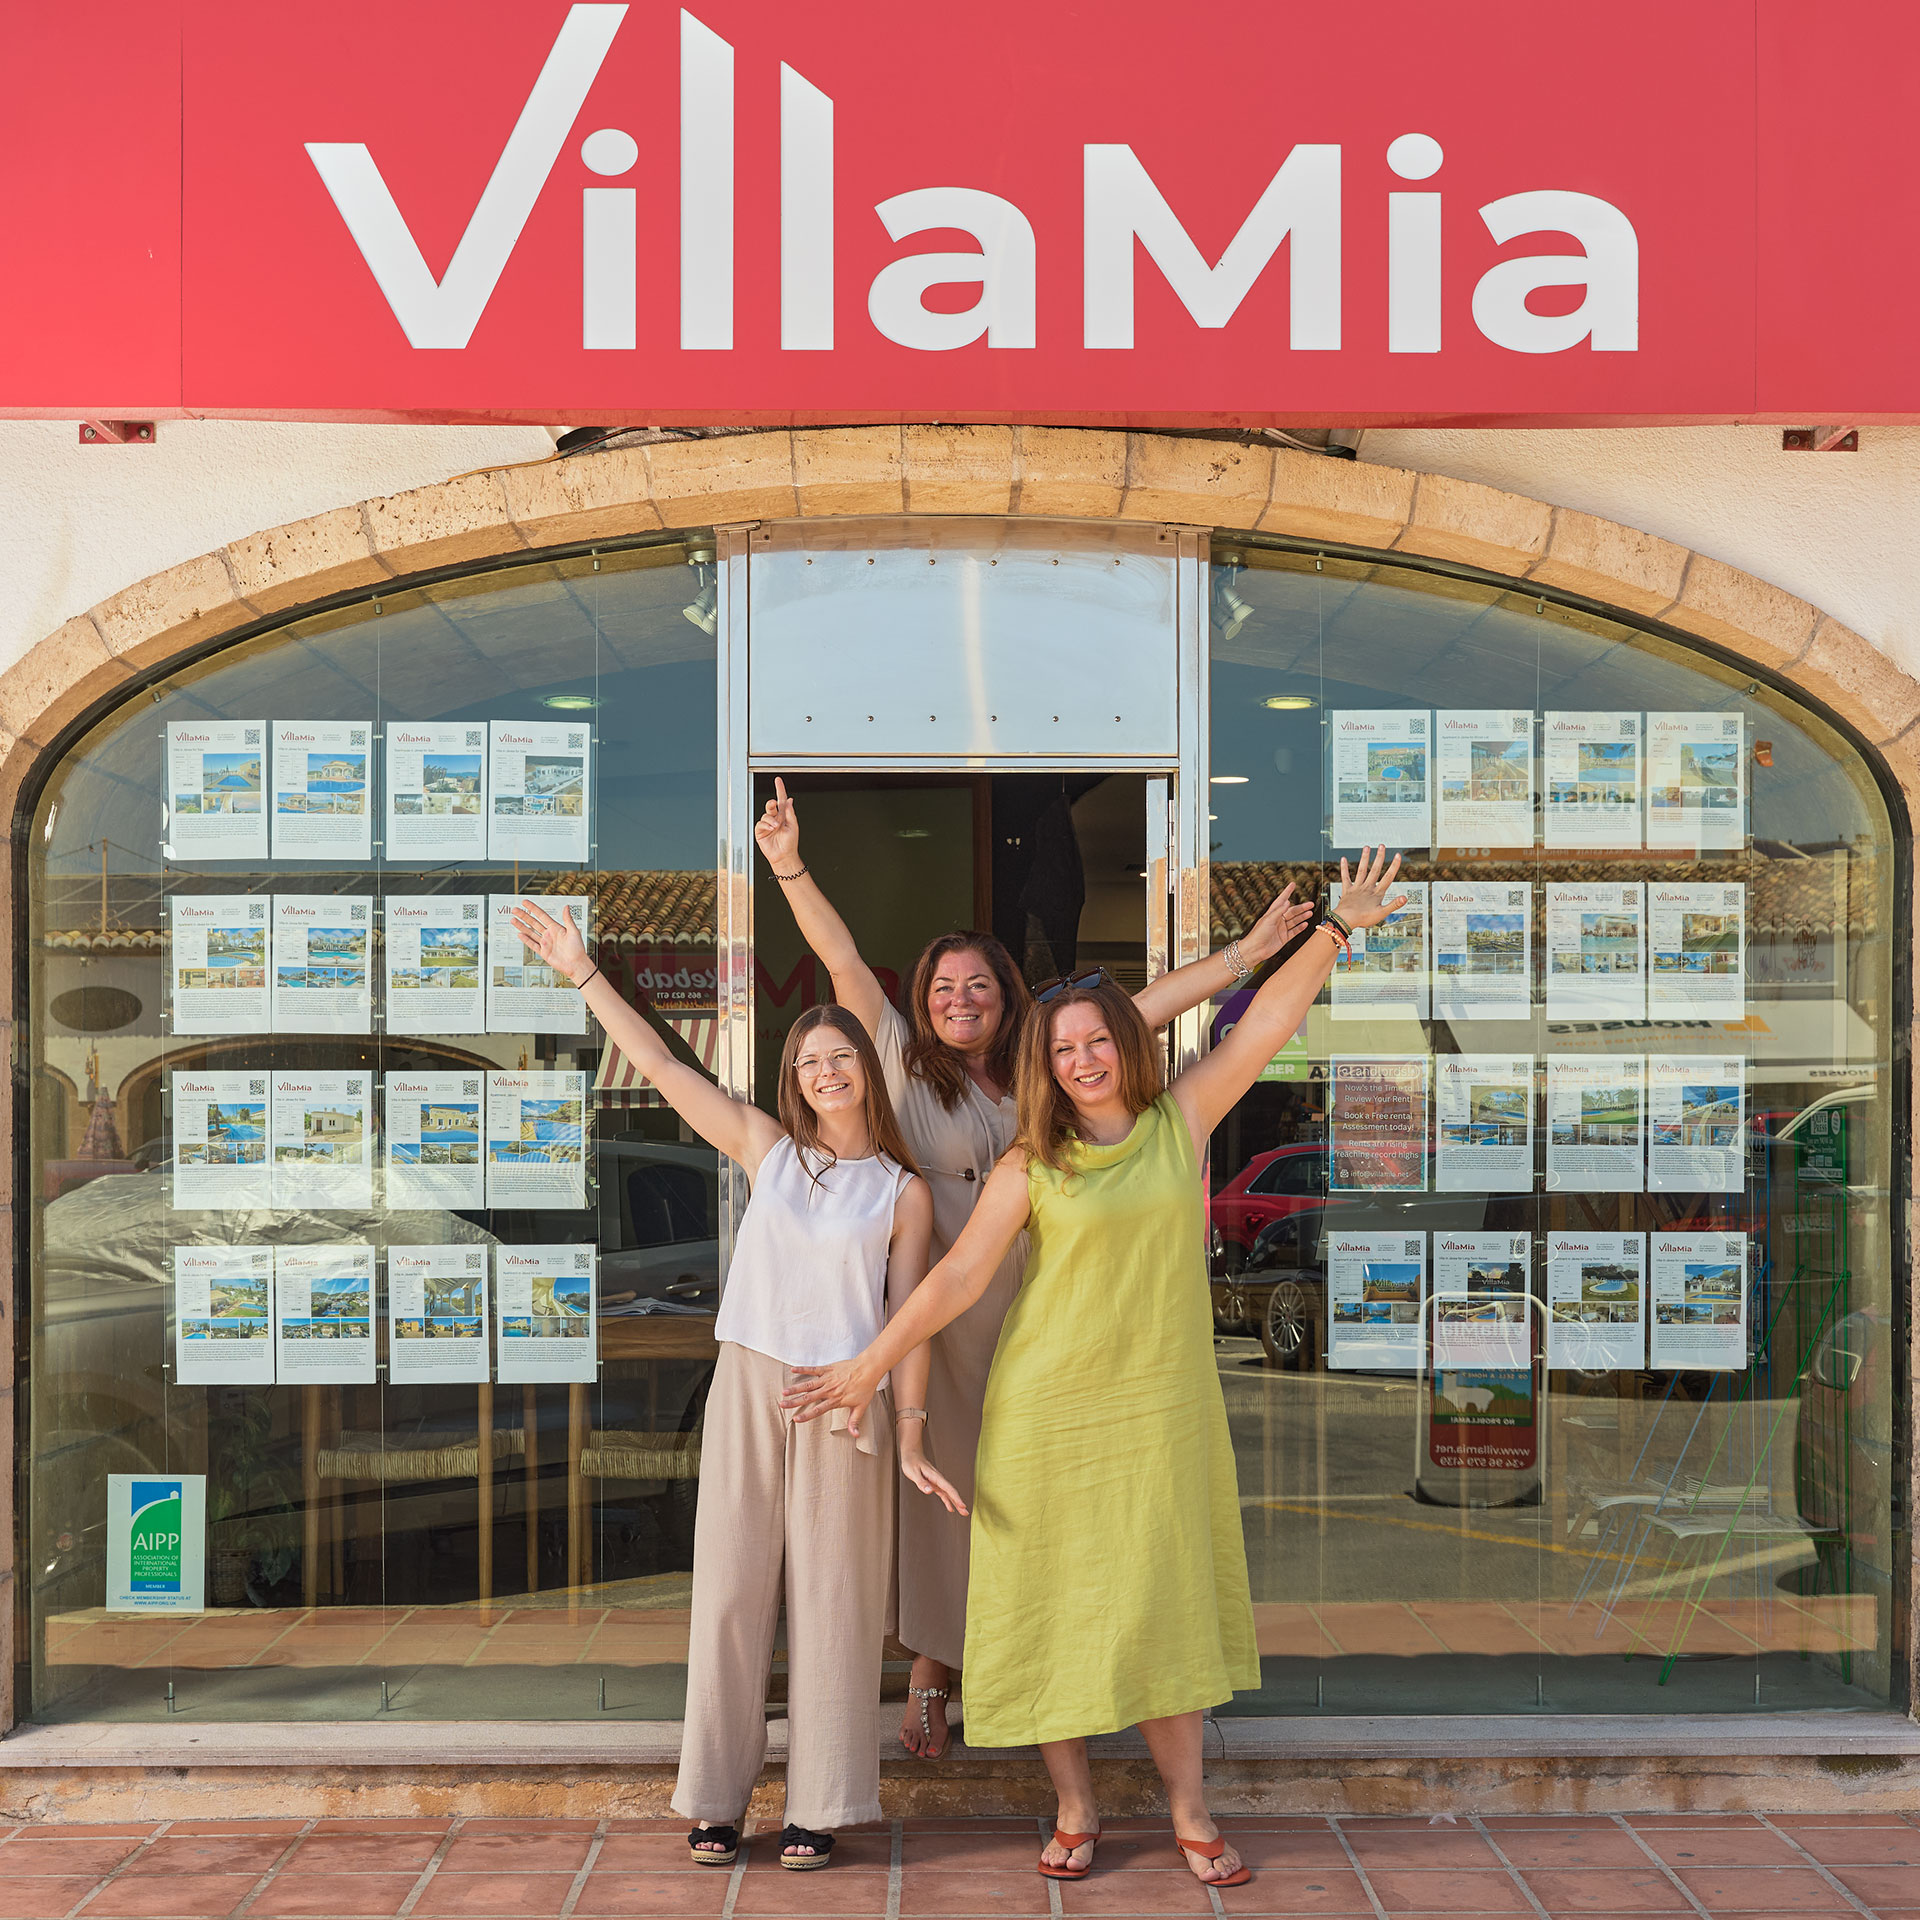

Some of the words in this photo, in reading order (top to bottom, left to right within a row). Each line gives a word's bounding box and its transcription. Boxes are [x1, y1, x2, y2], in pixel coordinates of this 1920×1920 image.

[304, 2, 1639, 354] VillaMia
[1340, 721, 1375, 731] VillaMia
[1444, 720, 1478, 729] VillaMia
[1552, 721, 1586, 731] VillaMia
[1654, 721, 1688, 731] VillaMia
[176, 732, 210, 742] VillaMia
[281, 731, 316, 741] VillaMia
[396, 733, 431, 742] VillaMia
[498, 733, 534, 744] VillaMia
[1440, 892, 1474, 902] VillaMia
[1554, 892, 1588, 902] VillaMia
[1656, 892, 1690, 902] VillaMia
[180, 906, 214, 916] VillaMia
[281, 906, 316, 916] VillaMia
[394, 906, 428, 916] VillaMia
[1444, 1063, 1478, 1073] VillaMia
[1555, 1064, 1589, 1073] VillaMia
[1656, 1064, 1690, 1073] VillaMia
[492, 1076, 529, 1087] VillaMia
[180, 1082, 215, 1092] VillaMia
[277, 1082, 312, 1092] VillaMia
[394, 1082, 428, 1092] VillaMia
[1345, 1084, 1368, 1092] Now's
[1370, 1084, 1382, 1092] the
[1344, 1095, 1371, 1103] Review
[1373, 1095, 1391, 1103] Your
[1392, 1095, 1413, 1103] Rent!
[1344, 1112, 1364, 1120] Book
[1372, 1112, 1389, 1120] Free
[1390, 1112, 1413, 1120] rental
[1342, 1123, 1388, 1131] Assessment
[1390, 1123, 1415, 1132] today!
[1336, 1150, 1370, 1160] reaching
[1372, 1150, 1397, 1158] record
[1398, 1150, 1419, 1160] highs
[1336, 1242, 1371, 1252] VillaMia
[1441, 1240, 1476, 1250] VillaMia
[1555, 1241, 1589, 1251] VillaMia
[1658, 1242, 1692, 1252] VillaMia
[183, 1257, 217, 1267] VillaMia
[505, 1255, 540, 1265] VillaMia
[133, 1533, 179, 1550] AIPP
